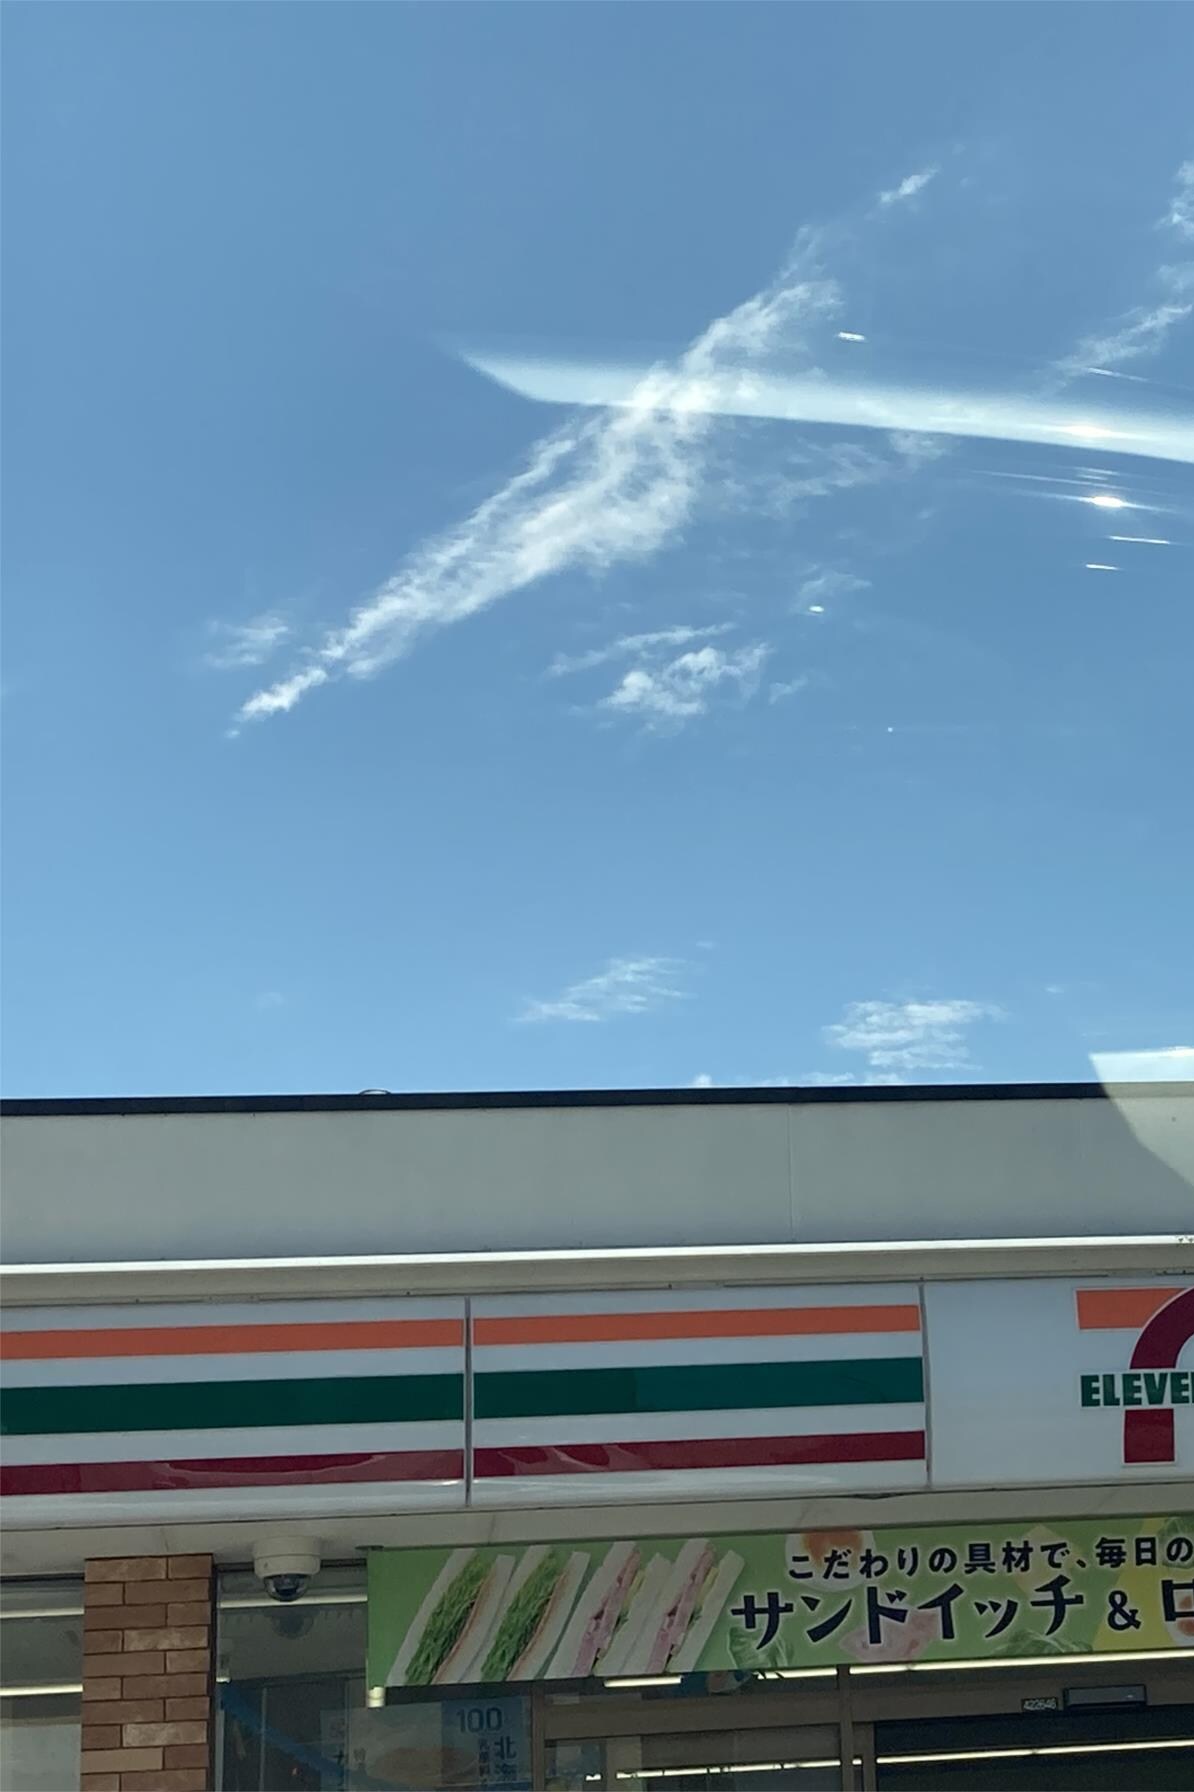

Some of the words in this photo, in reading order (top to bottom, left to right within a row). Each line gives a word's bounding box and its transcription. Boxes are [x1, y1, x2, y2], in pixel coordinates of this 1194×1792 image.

[730, 1574, 1084, 1650] サンドイッチ
[1107, 1590, 1142, 1631] &
[456, 1706, 503, 1733] 100
